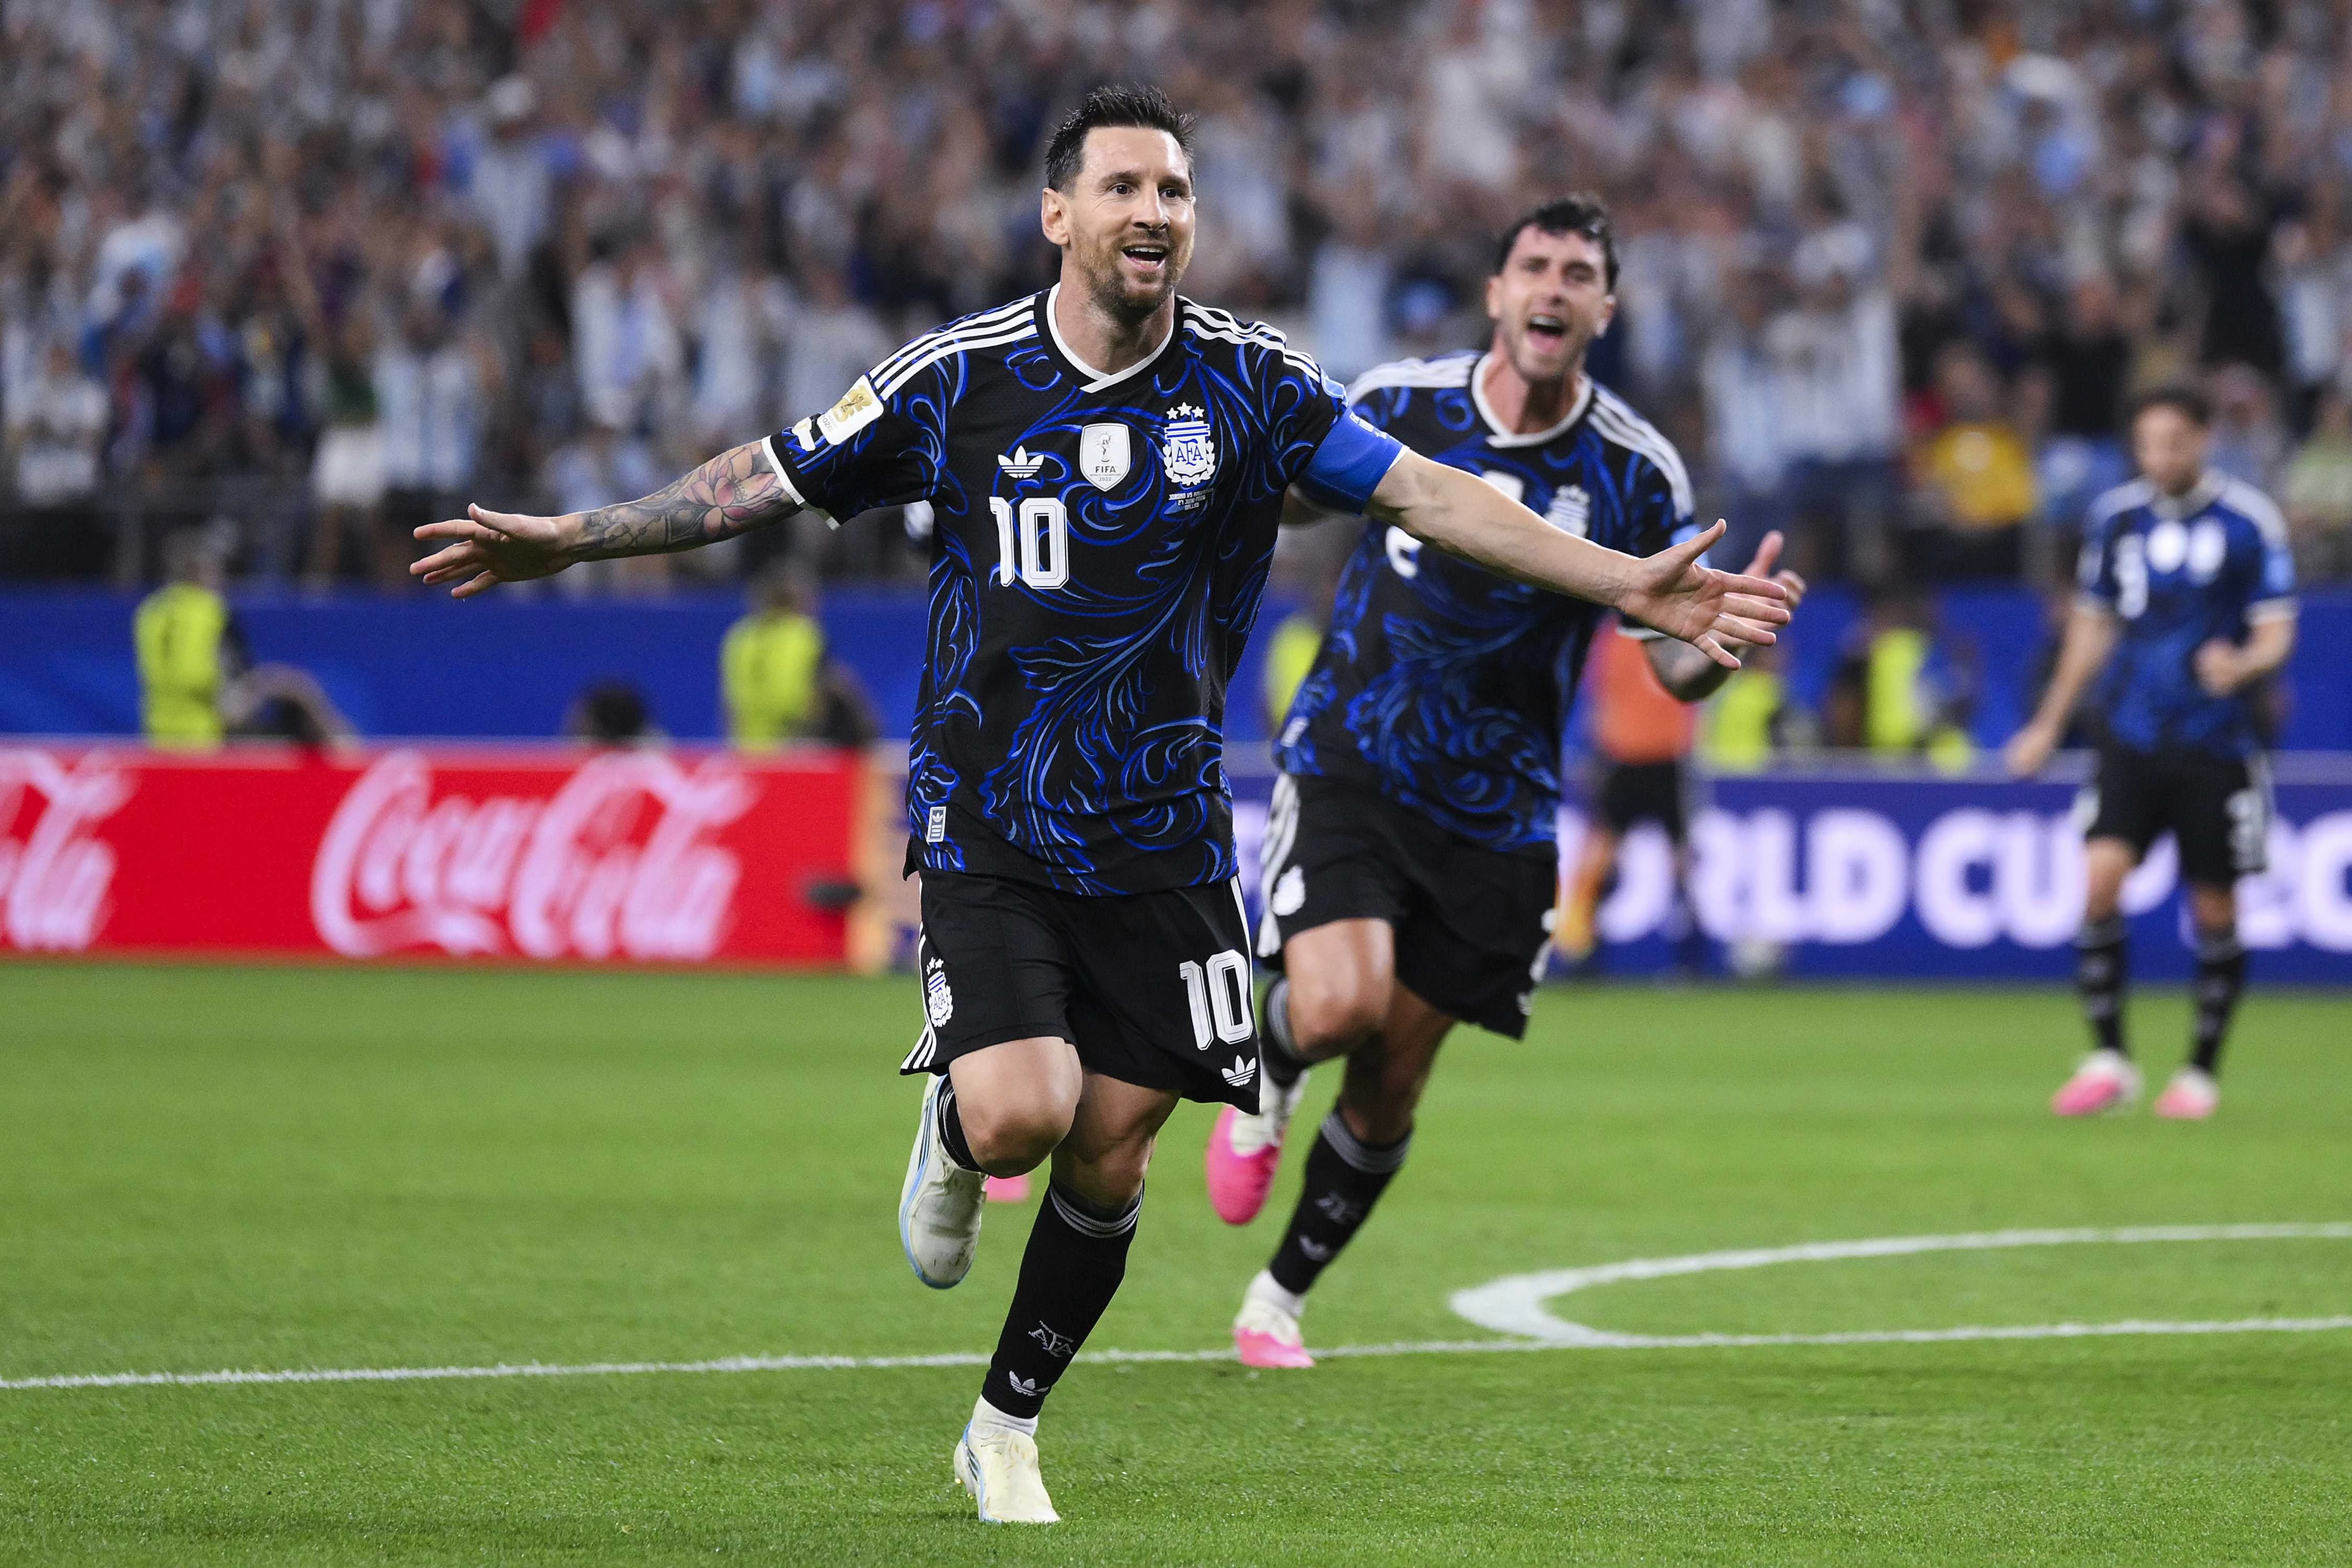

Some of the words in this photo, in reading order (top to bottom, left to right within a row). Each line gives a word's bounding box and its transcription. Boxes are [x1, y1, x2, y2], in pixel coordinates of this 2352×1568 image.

[1175, 438, 1204, 466] AFA
[989, 497, 1069, 589] 10
[1555, 805, 1910, 944] ORLD
[1180, 949, 1253, 1051] 10
[1028, 1320, 1074, 1357] AFA
